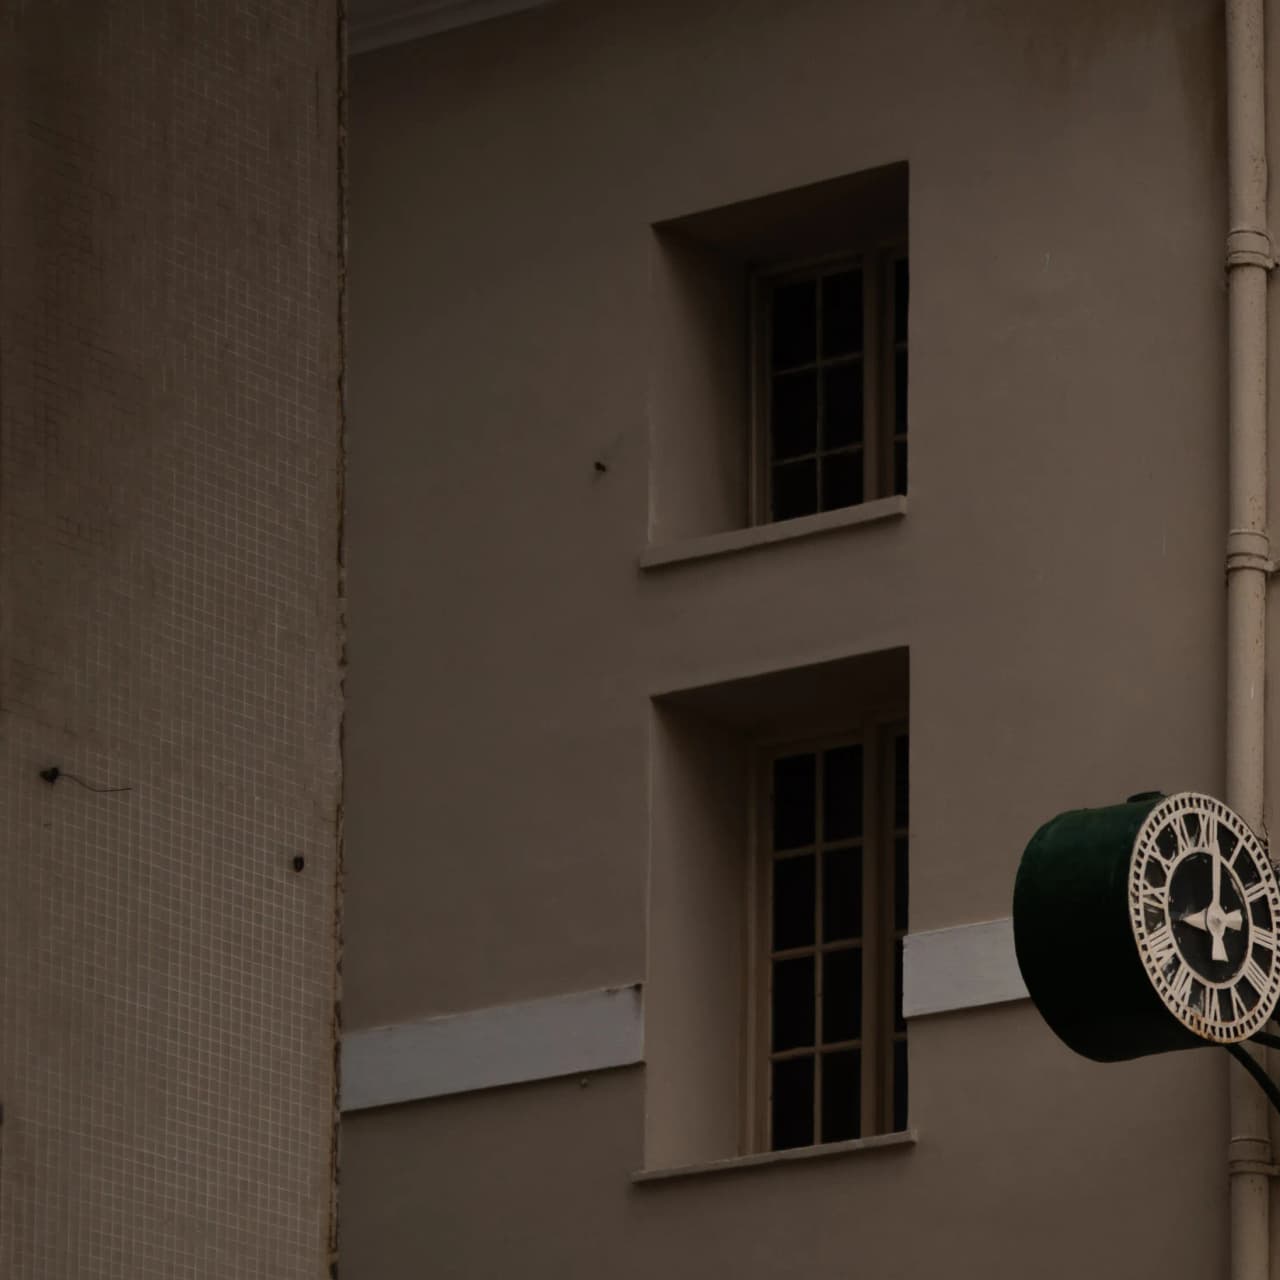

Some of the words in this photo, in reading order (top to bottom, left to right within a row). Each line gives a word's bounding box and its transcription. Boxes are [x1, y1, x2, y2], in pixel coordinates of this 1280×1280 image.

[1170, 814, 1190, 856] XI
[1198, 814, 1218, 849] XII
[1147, 840, 1178, 878] X
[1228, 839, 1244, 868] I
[1142, 882, 1168, 910] IX
[1245, 880, 1267, 903] II
[1147, 926, 1178, 969] VIII
[1251, 925, 1274, 950] III
[1171, 962, 1194, 1007] VII
[1245, 957, 1270, 996] IIII
[1205, 986, 1221, 1022] VI
[1230, 986, 1247, 1021] V
